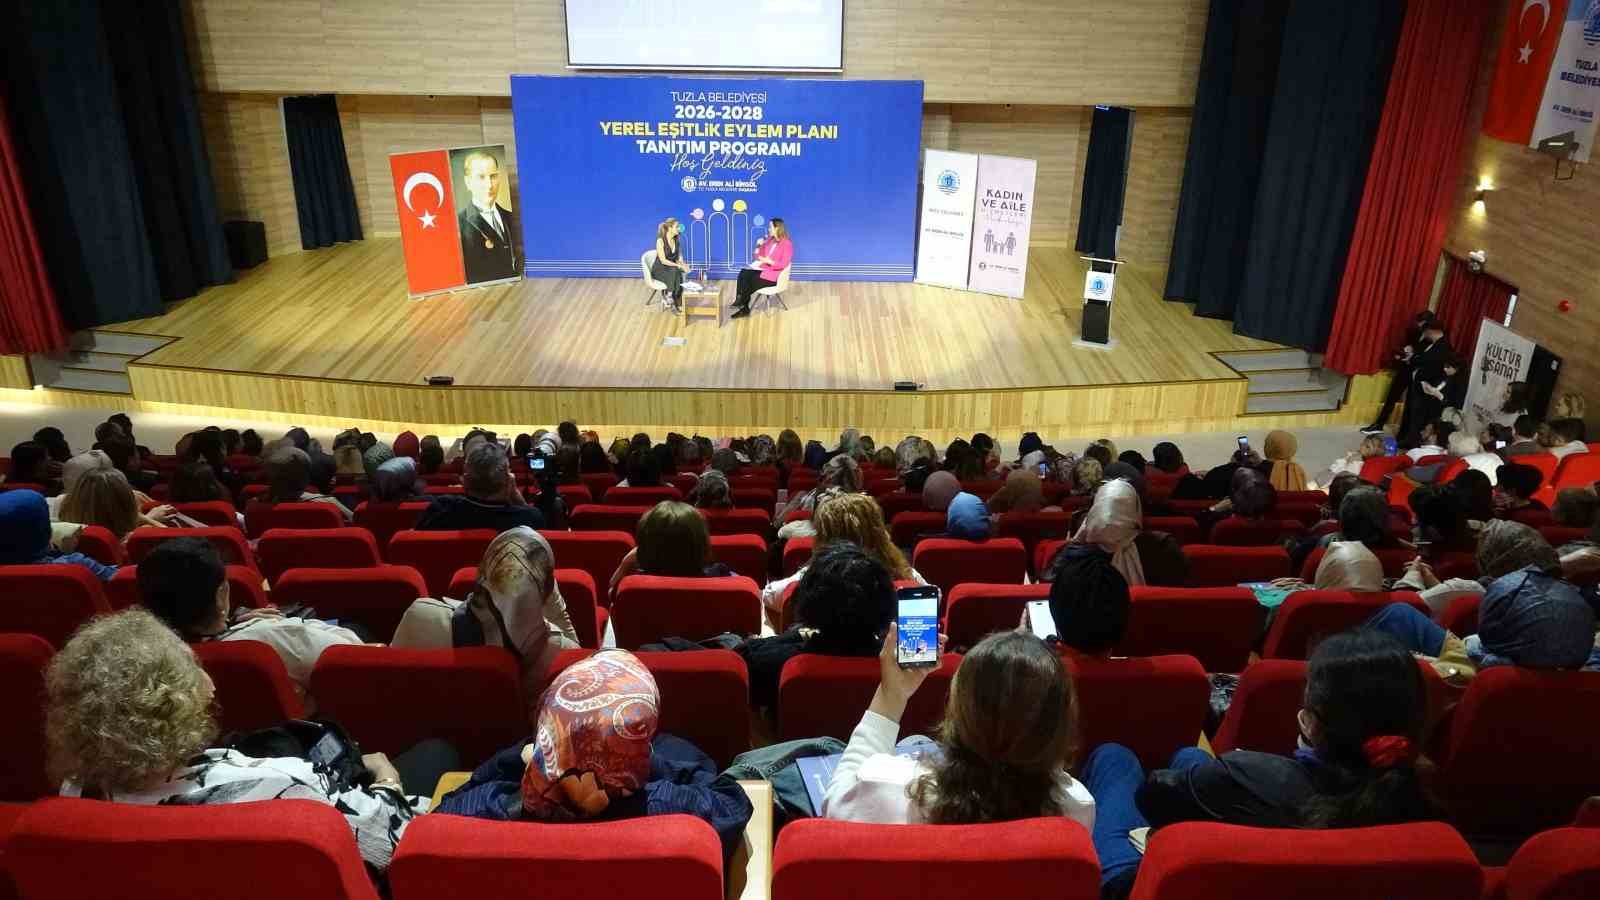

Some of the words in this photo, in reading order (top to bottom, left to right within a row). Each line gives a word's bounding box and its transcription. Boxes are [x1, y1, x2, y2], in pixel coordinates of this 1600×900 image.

[670, 92, 706, 102] TUZLA
[709, 91, 767, 104] BELEDİYESİ
[674, 105, 763, 120] 2026-2028
[600, 122, 656, 136] YEREL
[724, 123, 782, 138] EYLEM
[786, 124, 838, 139] PLANI
[636, 140, 706, 154] TANITIM
[709, 141, 801, 156] PROGRAMI
[699, 152, 768, 181] Geldiniz
[986, 189, 1023, 200] KADIN
[982, 199, 997, 208] VE
[1487, 359, 1520, 382] SANAT
